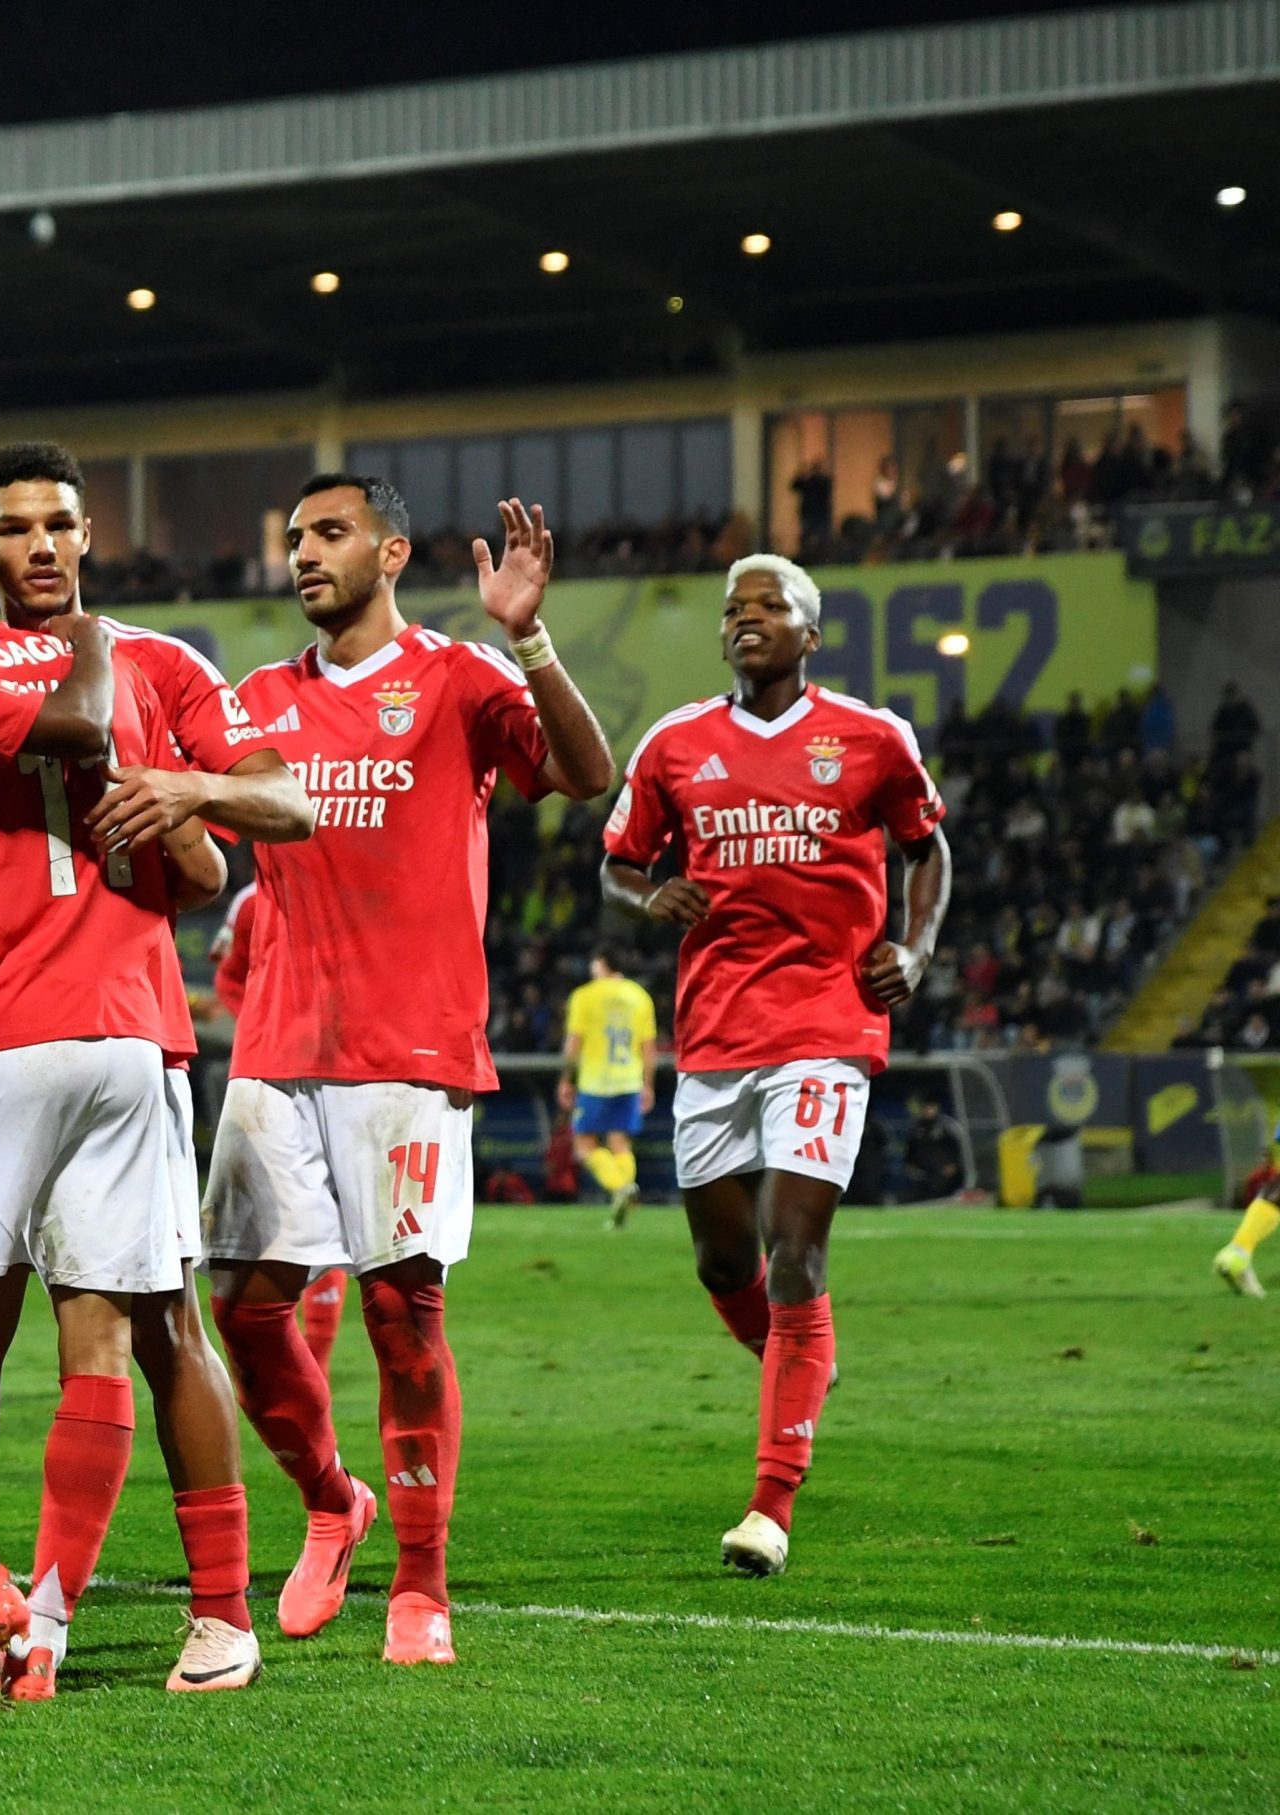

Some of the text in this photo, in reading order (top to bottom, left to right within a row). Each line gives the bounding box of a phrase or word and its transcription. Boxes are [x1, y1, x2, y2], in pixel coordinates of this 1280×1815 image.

[692, 798, 841, 840] Emirates
[718, 835, 821, 868] FLY BETTER
[387, 1142, 440, 1208] 14
